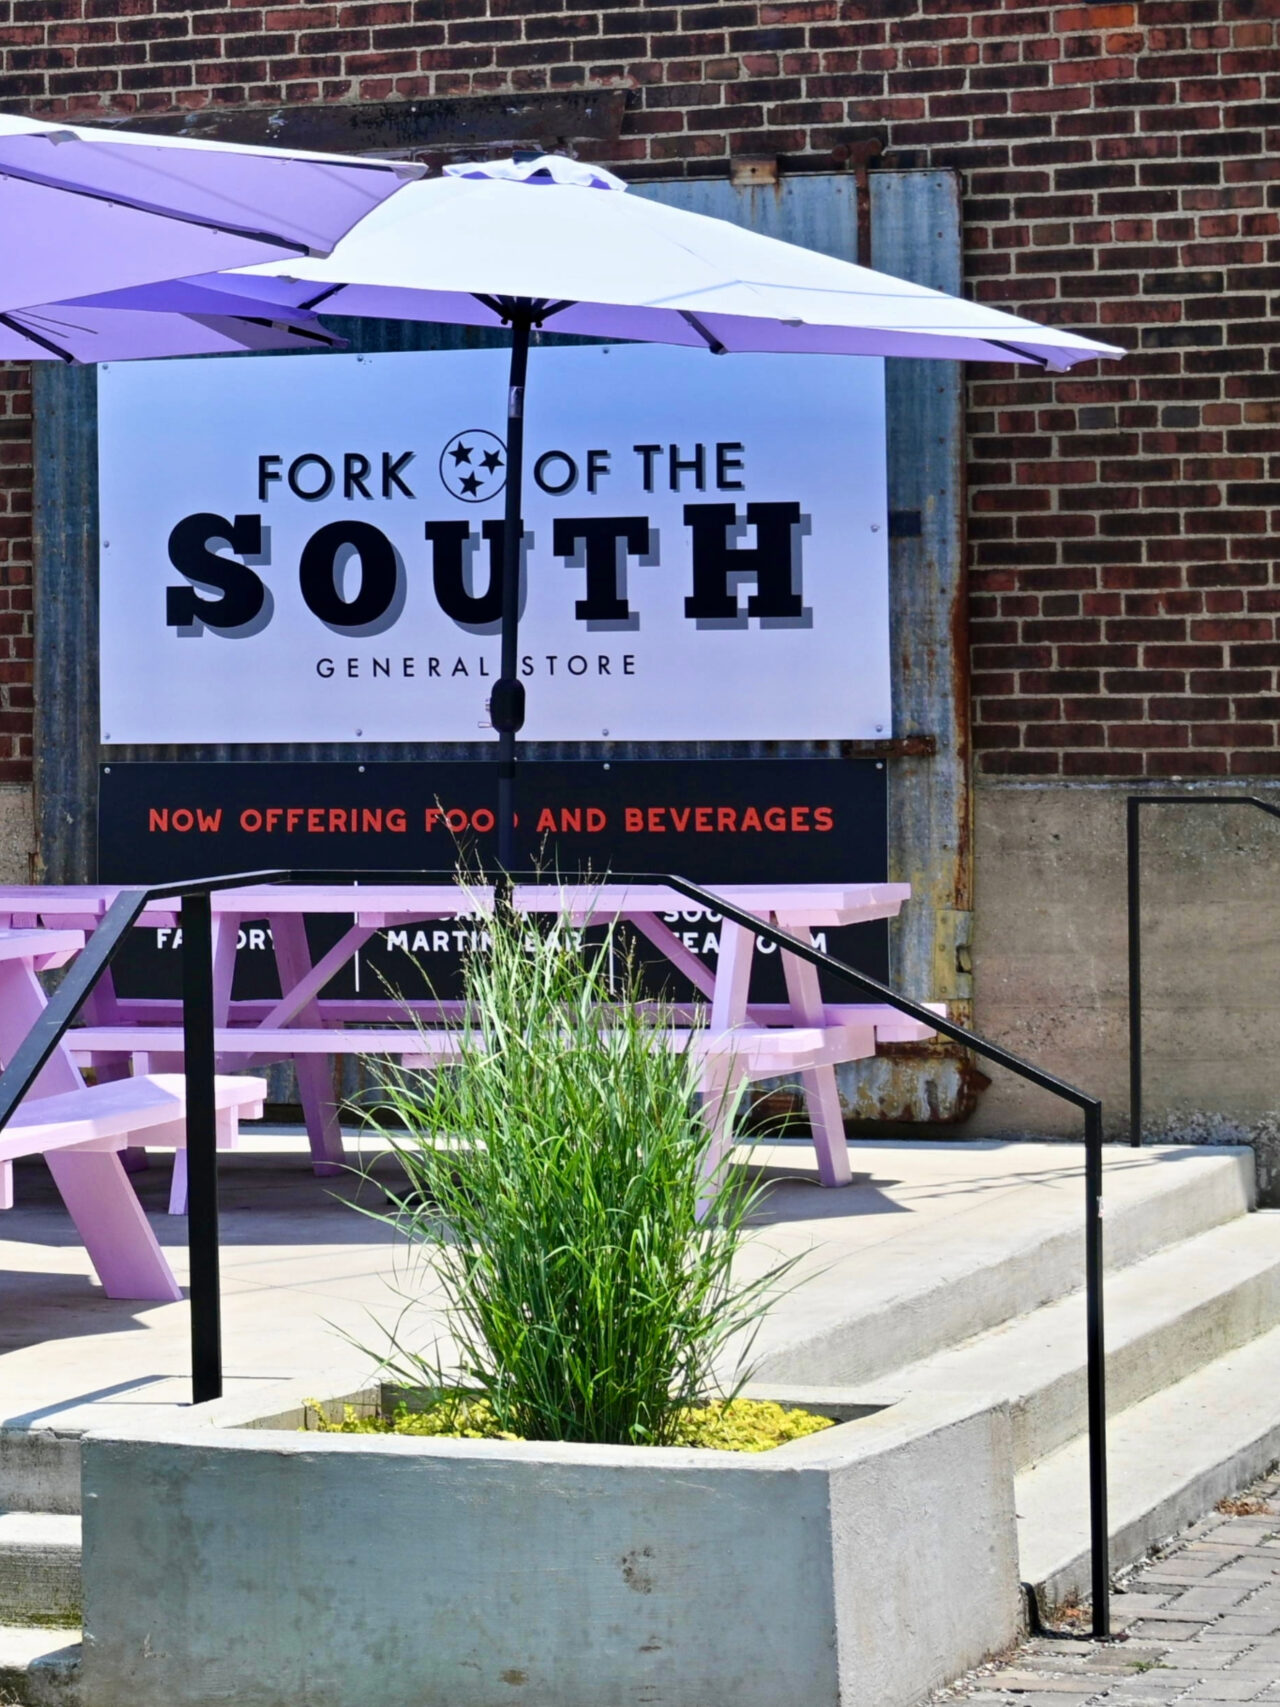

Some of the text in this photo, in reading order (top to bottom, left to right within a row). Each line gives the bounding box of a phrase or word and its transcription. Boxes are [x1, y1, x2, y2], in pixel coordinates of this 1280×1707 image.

[258, 441, 745, 502] FORK OF THE
[166, 502, 813, 639] SOUTH
[316, 654, 636, 678] GENERAL STORE
[149, 807, 834, 832] NOW OFFERING FOO AND BEVERAGES
